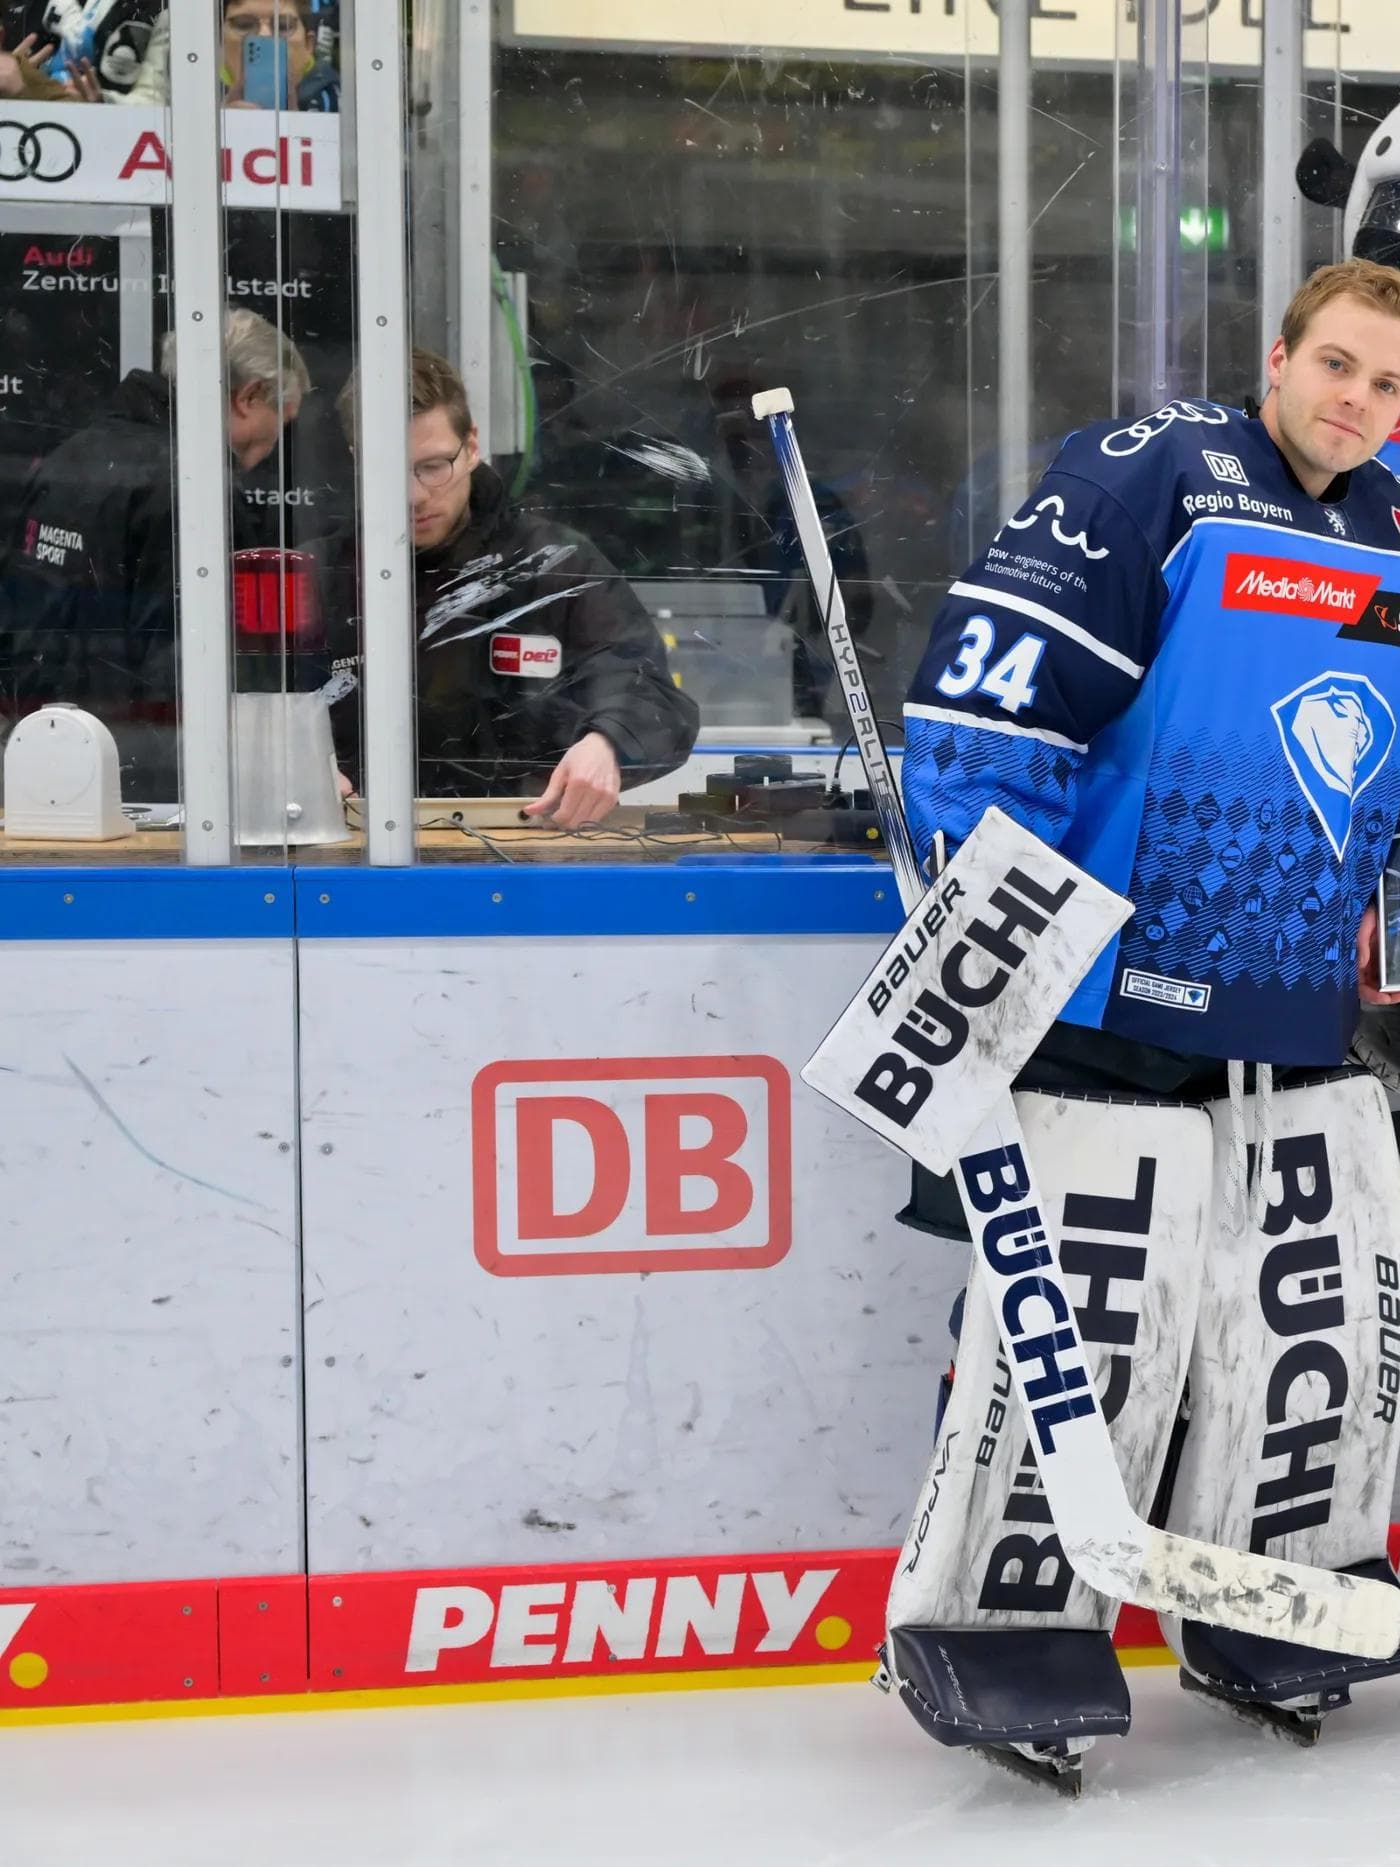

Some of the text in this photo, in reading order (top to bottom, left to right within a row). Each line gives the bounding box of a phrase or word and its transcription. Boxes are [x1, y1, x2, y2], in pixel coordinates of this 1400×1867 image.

[23, 245, 95, 268] Audi
[22, 269, 148, 292] Zentrum
[1211, 454, 1243, 481] DB
[1182, 490, 1293, 522] Regio Bayern
[39, 523, 84, 551] MAGENTA
[36, 542, 67, 566] SPORT
[987, 547, 1009, 561] psw
[1014, 553, 1059, 576] engineers
[1060, 569, 1074, 583] of
[984, 561, 1063, 595] automotive future
[936, 614, 1048, 716] 34
[853, 866, 1078, 1129] BÜCHL
[516, 1092, 754, 1240] DB
[958, 1141, 1097, 1456] BÜCHL
